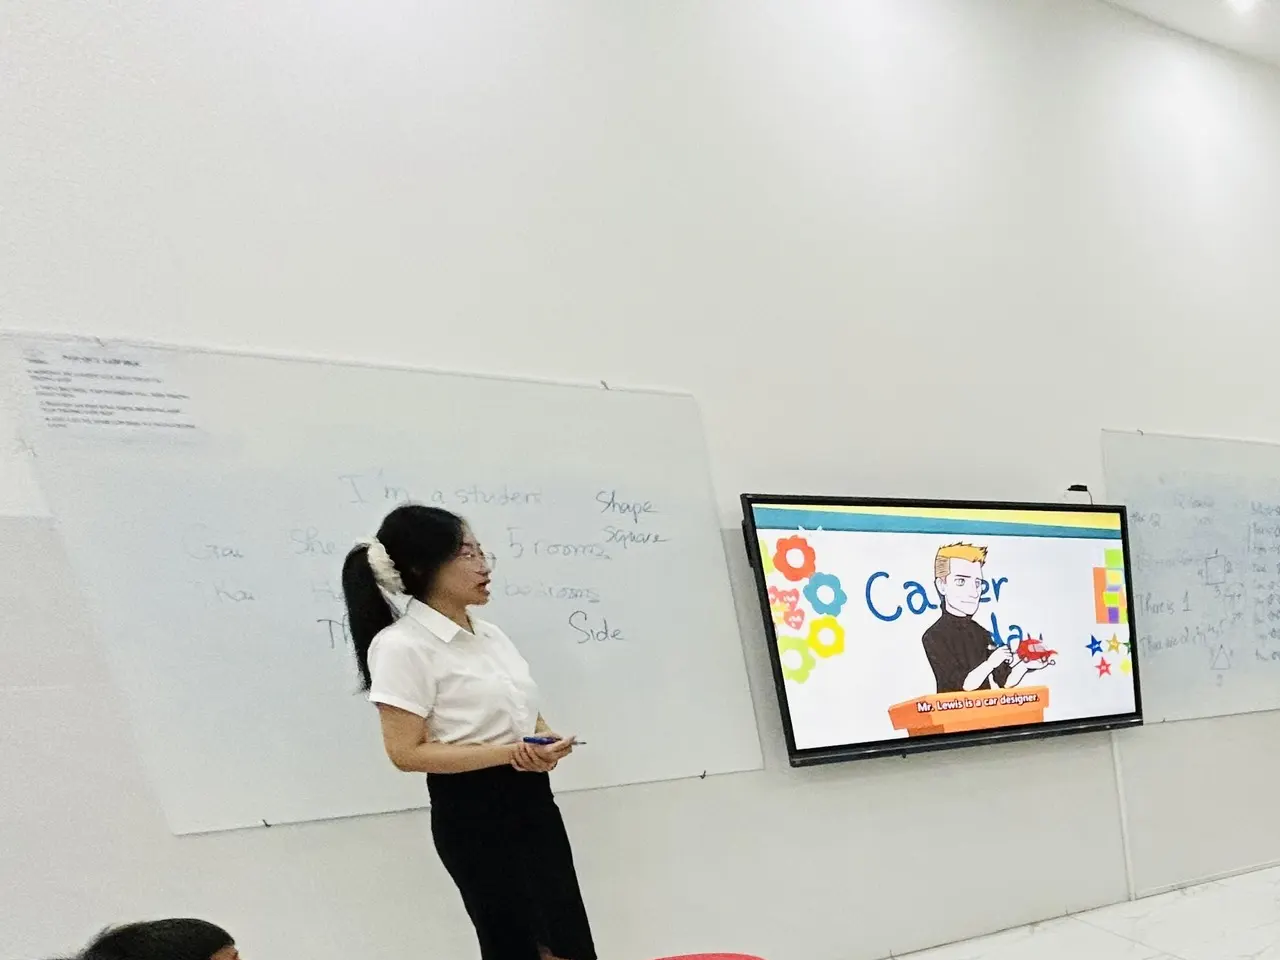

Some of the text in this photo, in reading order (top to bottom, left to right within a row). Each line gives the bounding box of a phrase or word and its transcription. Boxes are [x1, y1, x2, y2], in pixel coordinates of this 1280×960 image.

[596, 490, 658, 522] Shape
[569, 610, 624, 644] Side
[917, 702, 934, 712] Mr.
[937, 700, 963, 711] Lewis
[965, 698, 974, 708] is
[984, 698, 998, 706] car
[1000, 693, 1039, 706] designer.
